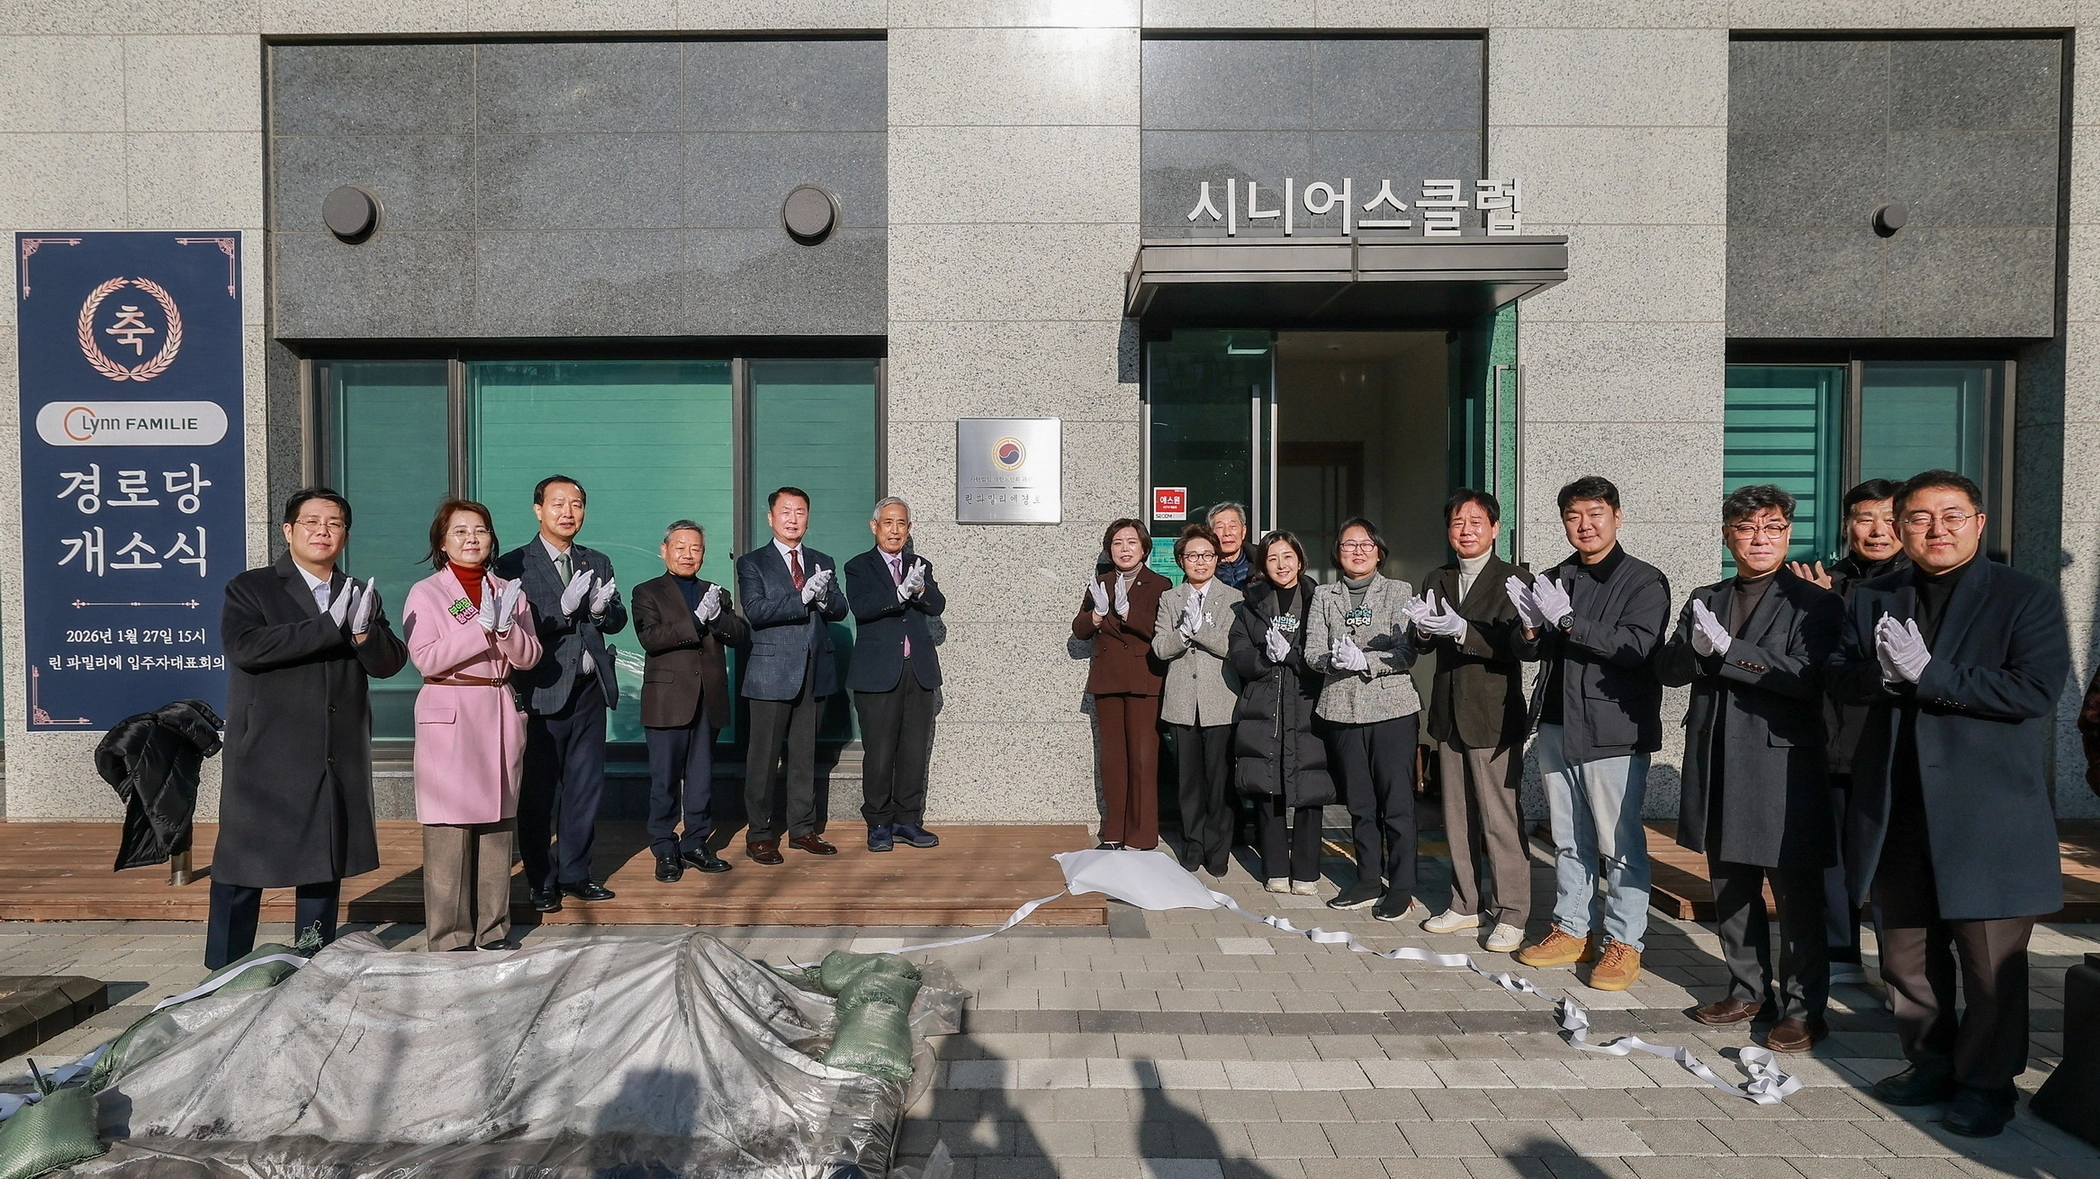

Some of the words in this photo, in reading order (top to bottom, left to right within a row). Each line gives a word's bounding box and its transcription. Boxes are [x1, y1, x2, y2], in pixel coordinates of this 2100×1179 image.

[1186, 177, 1522, 237] 시니어스클럽
[105, 305, 155, 356] 축
[82, 415, 120, 435] Lynn
[126, 418, 198, 430] FAMILIE
[57, 462, 212, 514] 경로당
[1159, 496, 1181, 504] 에스원
[57, 526, 208, 578] 개소식
[66, 628, 113, 644] 2026년
[117, 628, 138, 644] 1월
[142, 628, 173, 644] 27일
[177, 628, 206, 644] 15시
[49, 655, 62, 670] 린
[66, 655, 122, 670] 파밀리에
[127, 655, 226, 670] 입주자대표회의
